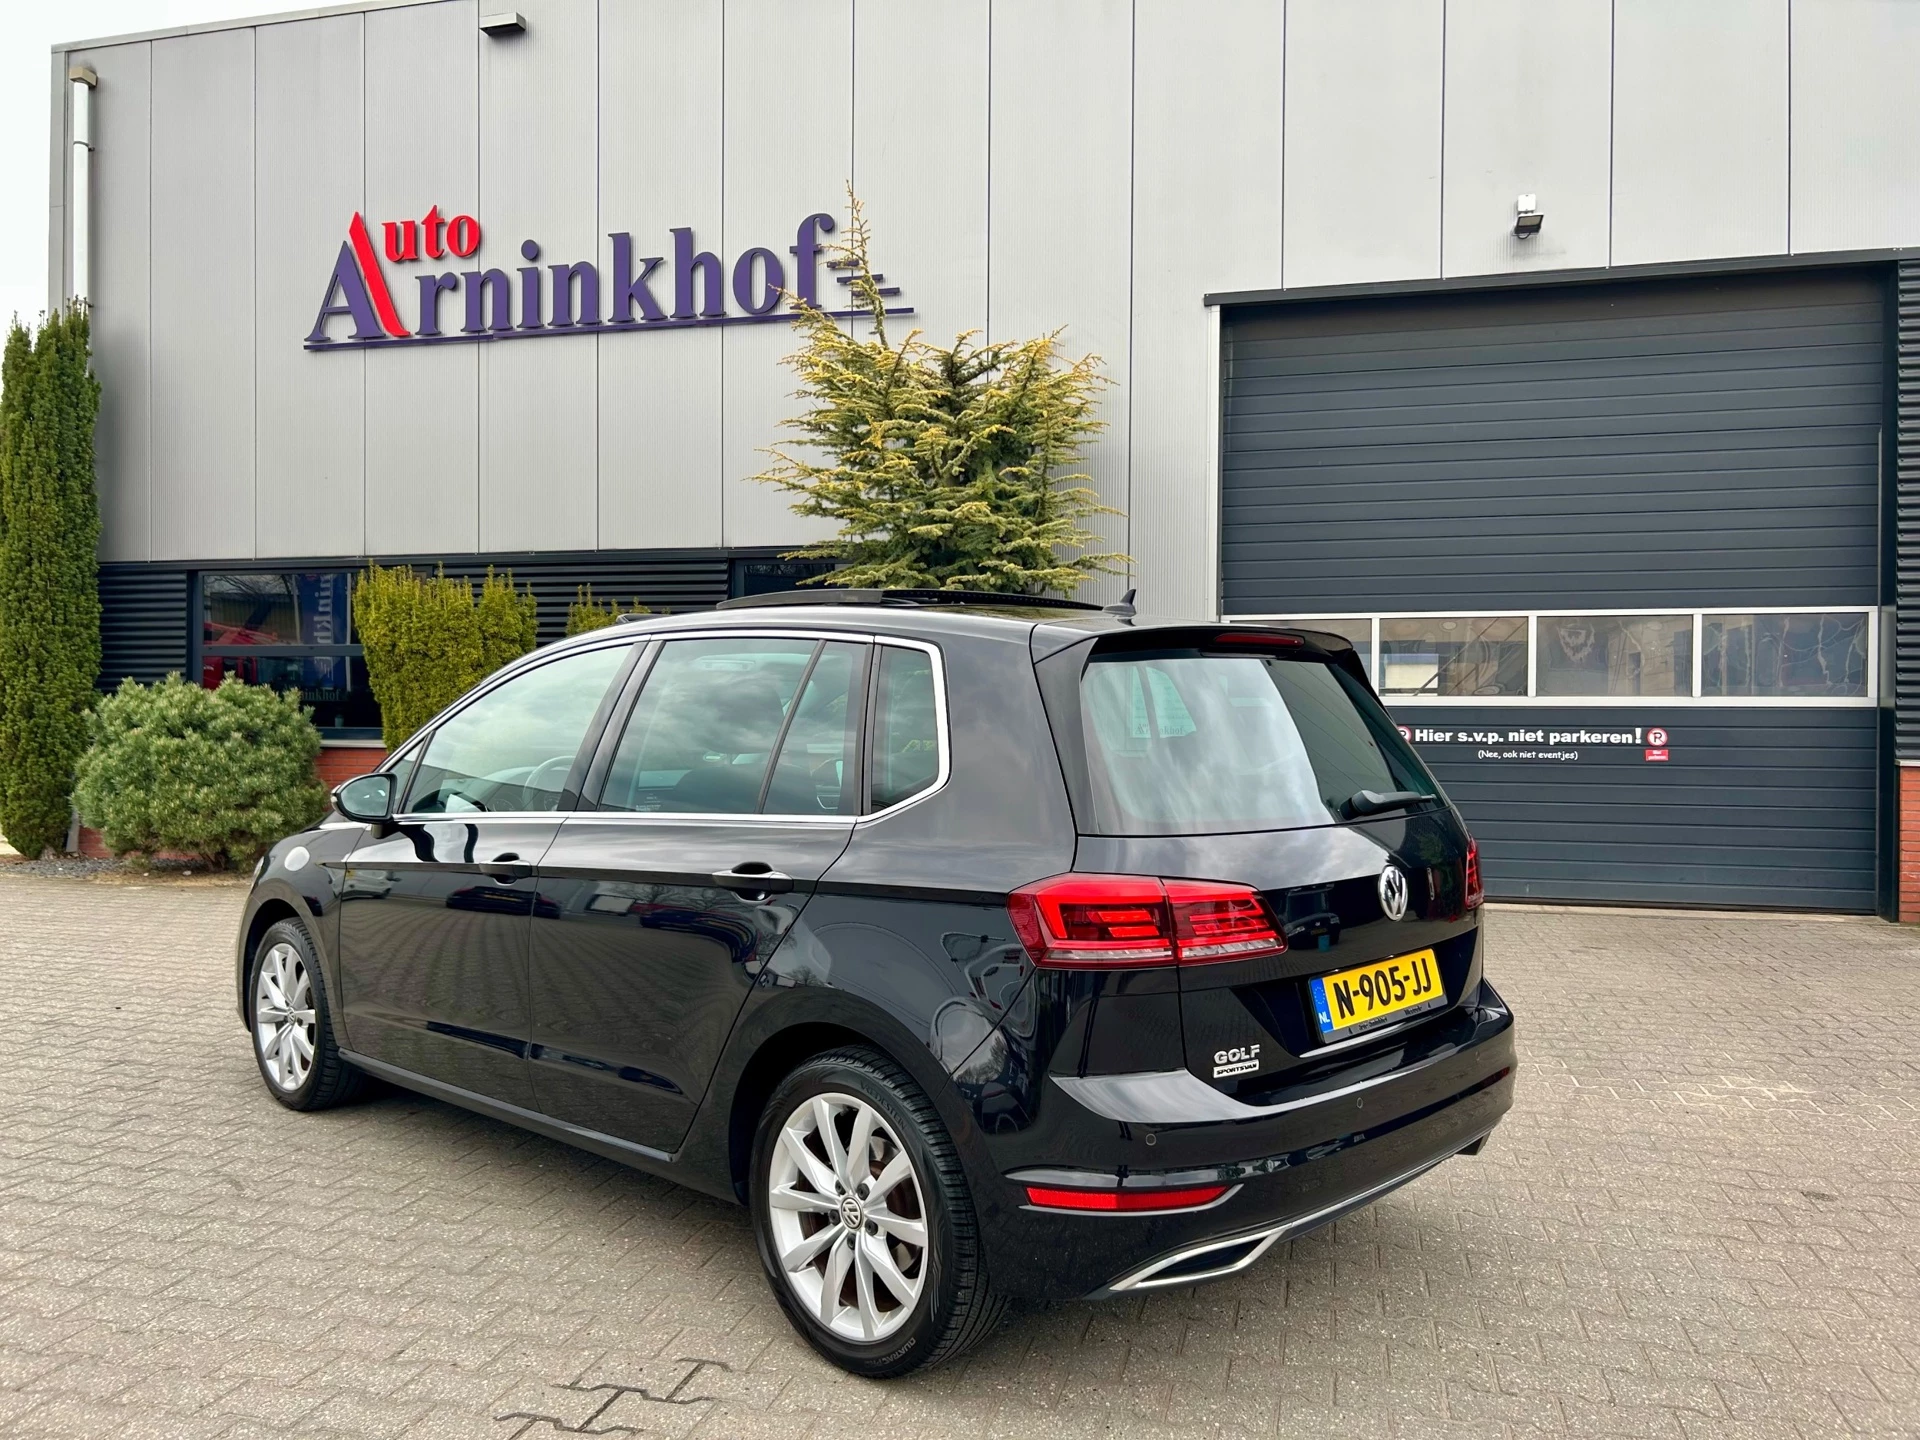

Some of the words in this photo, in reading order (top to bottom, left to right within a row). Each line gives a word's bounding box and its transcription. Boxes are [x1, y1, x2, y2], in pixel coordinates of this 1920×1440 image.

[304, 212, 834, 342] Arninkhof
[1415, 729, 1453, 742] Hier
[1457, 729, 1504, 744] s.v.p.
[1508, 729, 1544, 743] niet
[1549, 728, 1642, 745] parkeren!
[1478, 750, 1502, 760] (Nee,
[1502, 750, 1518, 759] ook
[1519, 750, 1537, 759] niet
[1538, 750, 1579, 761] eventjes)
[1332, 957, 1432, 1020] N-905-JJ
[1318, 1011, 1331, 1024] NL
[1213, 1044, 1260, 1065] GOLF
